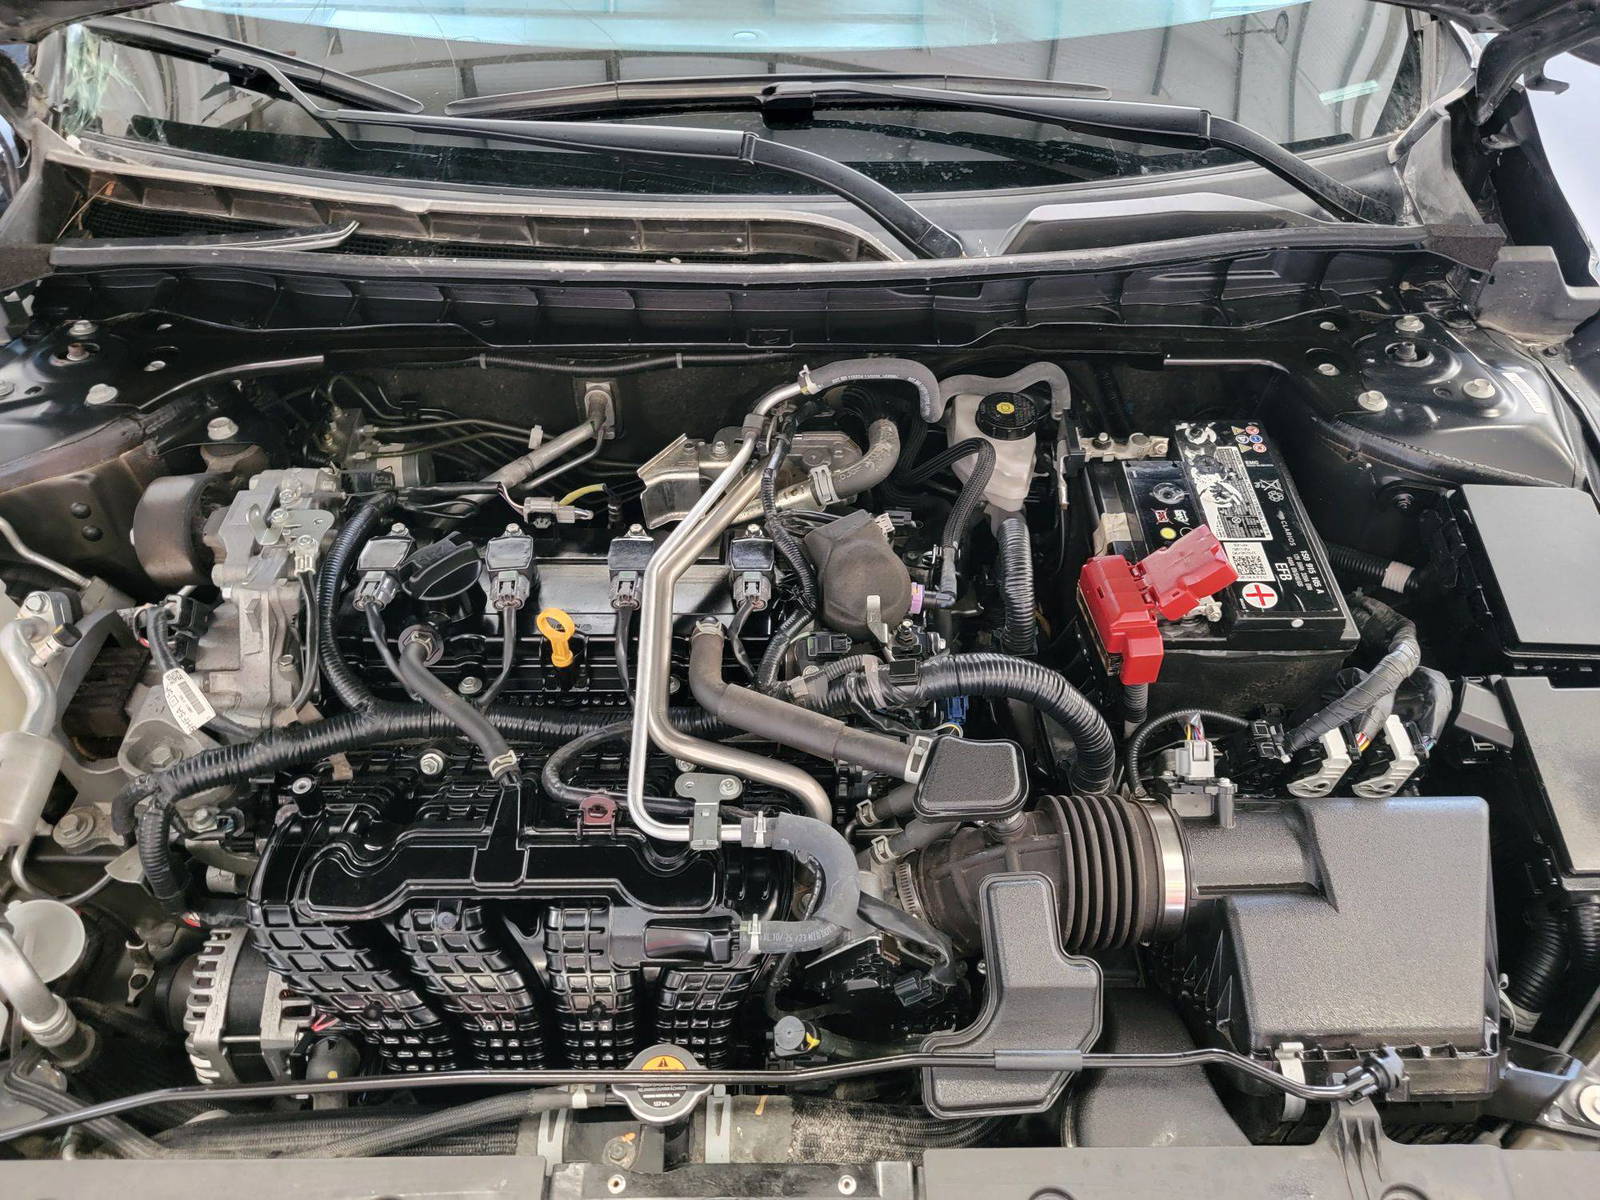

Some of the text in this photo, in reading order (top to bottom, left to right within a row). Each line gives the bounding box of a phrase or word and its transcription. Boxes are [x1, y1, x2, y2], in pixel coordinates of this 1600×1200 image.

[1281, 520, 1296, 546] CLARIOS
[1274, 562, 1292, 581] EFB
[1305, 563, 1316, 574] 915
